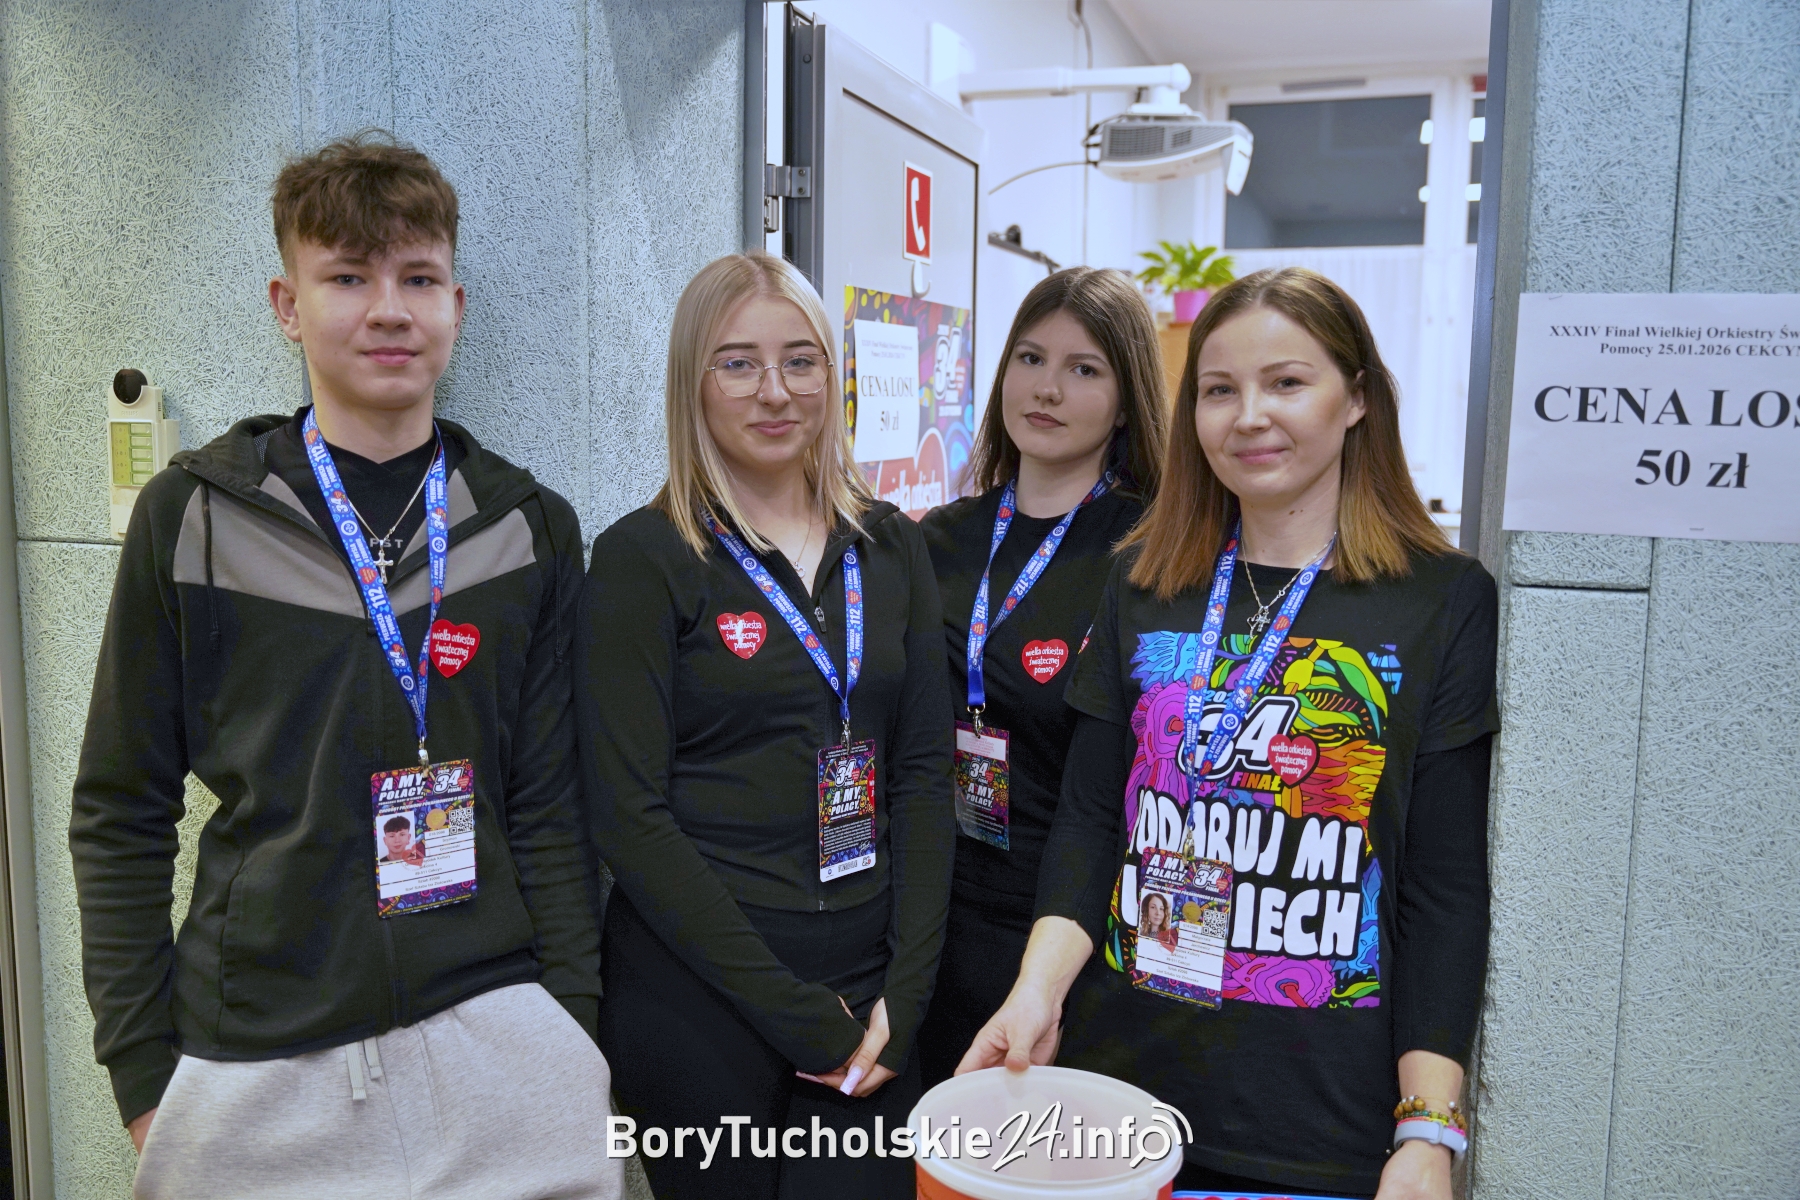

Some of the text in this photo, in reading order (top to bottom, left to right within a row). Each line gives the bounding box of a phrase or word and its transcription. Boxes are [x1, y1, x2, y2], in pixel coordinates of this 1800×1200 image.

[1549, 325, 1601, 337] XXXIV
[1604, 325, 1640, 338] Finał
[1645, 325, 1702, 341] Wielkiej
[1707, 326, 1775, 340] Orkiestry
[1600, 343, 1800, 357] Pomocy 25.01.2026 CEKCY
[860, 375, 915, 397] CENA LOSU
[1534, 385, 1693, 426] CENA
[879, 411, 891, 431] 50
[1635, 449, 1750, 489] 50 zł
[1220, 555, 1233, 572] 112
[368, 586, 387, 609] 112
[790, 615, 808, 634] 112
[432, 629, 476, 646] wielka orkiestra
[1263, 635, 1281, 653] 112
[434, 641, 469, 661] świątecznej
[1025, 646, 1064, 656] wielka orkiestra
[439, 656, 462, 670] pomocy
[1029, 656, 1060, 668] świątecznej
[1034, 666, 1055, 676] pomocy
[1188, 695, 1202, 714] 112
[1179, 698, 1297, 777] 34
[1271, 742, 1312, 756] wielka orkiestra
[970, 760, 990, 779] 34
[1275, 752, 1307, 770] świątecznej
[434, 767, 463, 794] 34
[835, 759, 856, 787] 34
[1281, 765, 1302, 778] pomocy
[380, 777, 393, 791] A
[1231, 771, 1281, 791] FINAŁ
[378, 786, 425, 801] POLACY,
[833, 790, 840, 805] A
[843, 786, 861, 802] MY,
[966, 792, 993, 808] POLACY,
[967, 782, 994, 800] A MY,
[831, 800, 859, 816] POLACY,
[1129, 790, 1363, 883] ODARUJ MI
[1149, 854, 1161, 866] A
[1146, 866, 1185, 882] POLACY,
[1193, 867, 1225, 888] 34
